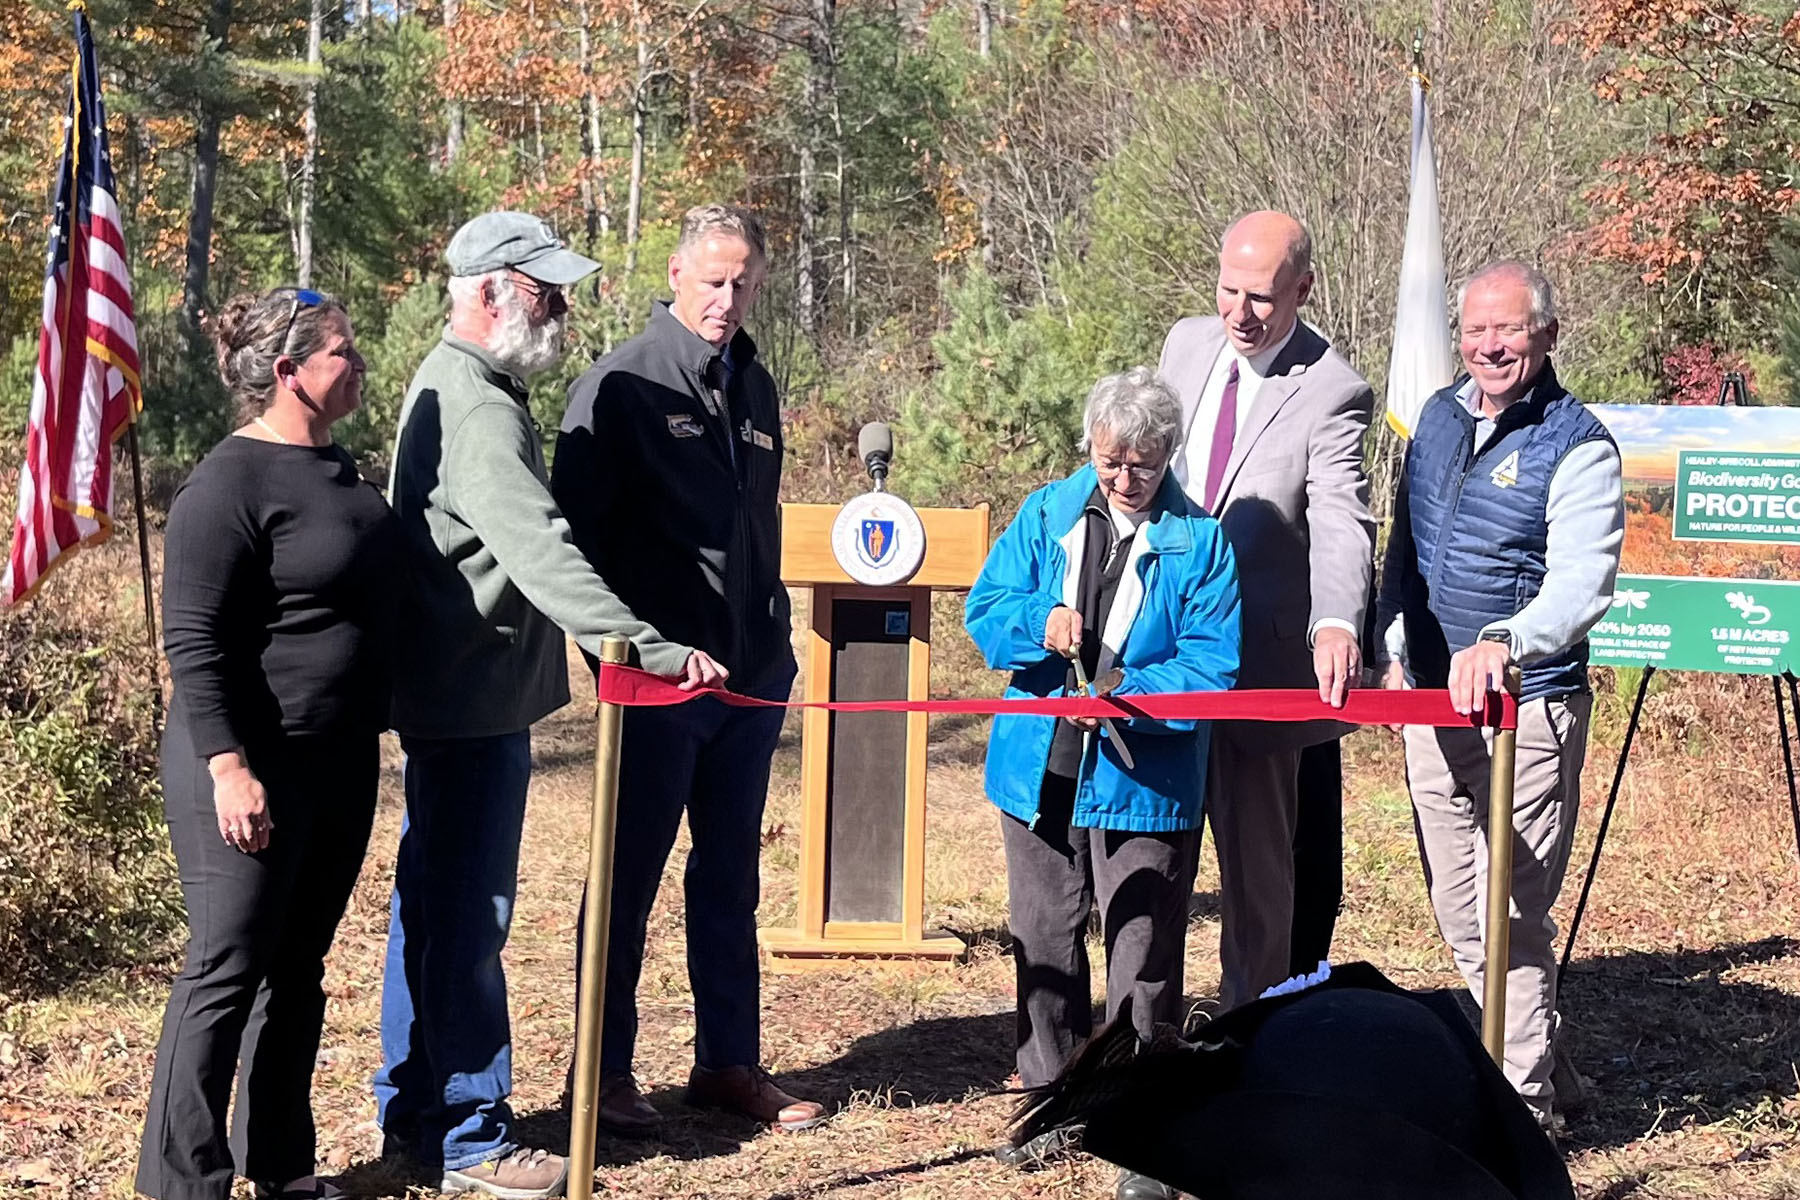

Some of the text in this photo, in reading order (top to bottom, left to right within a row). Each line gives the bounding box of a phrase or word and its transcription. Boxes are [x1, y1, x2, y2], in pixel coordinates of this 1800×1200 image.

[1688, 471, 1780, 490] Biodiversity
[1686, 492, 1800, 520] PROTEC
[1689, 522, 1722, 531] NATURE
[1723, 523, 1741, 532] FOR
[1741, 524, 1774, 532] PEOPLE
[1620, 622, 1636, 636] by
[1637, 624, 1670, 636] 2050
[1710, 627, 1790, 643] 1.5 M ACRES
[1622, 638, 1637, 648] THE
[1659, 641, 1671, 650] OF
[1717, 644, 1728, 652] OF
[1594, 648, 1666, 660] LAND PROTECTION
[1724, 655, 1774, 666] PROTECTED
